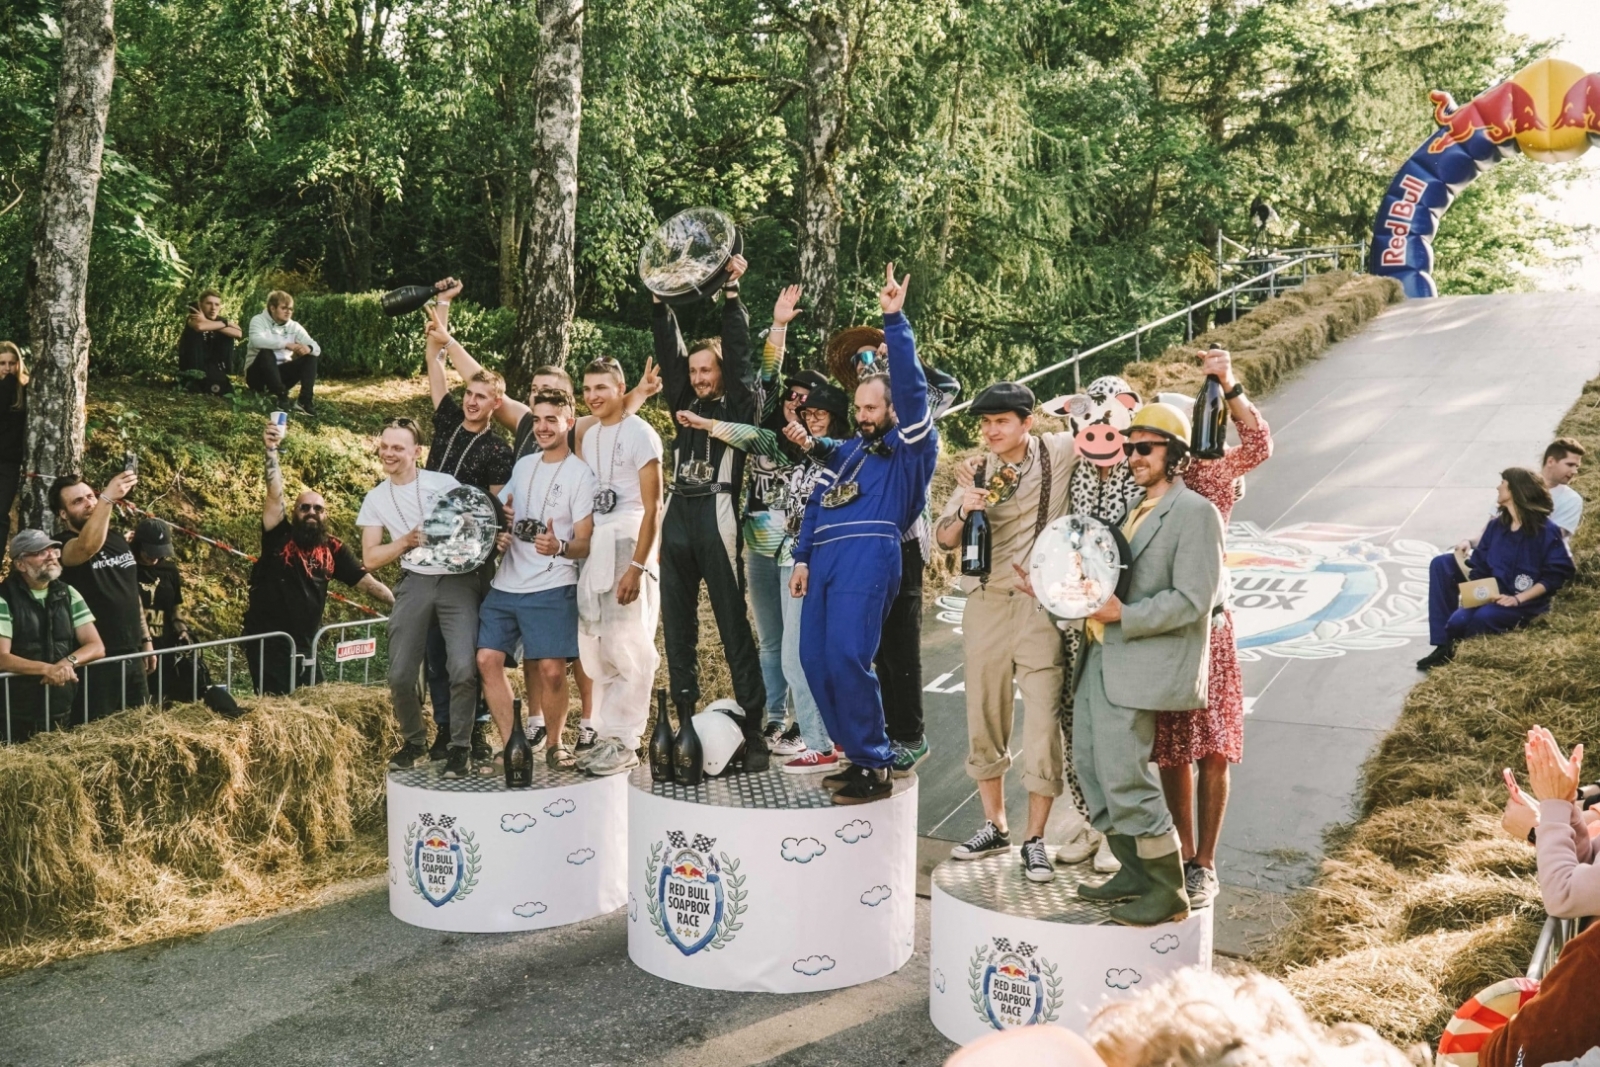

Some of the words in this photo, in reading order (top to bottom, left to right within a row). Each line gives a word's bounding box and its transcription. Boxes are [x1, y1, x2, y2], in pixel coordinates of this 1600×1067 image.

[1389, 175, 1427, 220] Bull
[1383, 220, 1410, 265] Red
[1230, 577, 1309, 593] ULL
[422, 852, 434, 863] RED
[436, 854, 453, 865] BULL
[421, 862, 454, 876] SOAPBOX
[428, 874, 446, 885] RACE
[669, 882, 685, 896] RED
[688, 886, 710, 901] BULL
[668, 896, 710, 915] SOAPBOX
[676, 912, 700, 927] RACE
[993, 979, 1009, 991] RED
[1011, 984, 1031, 997] BULL
[992, 990, 1032, 1007] SOAPBOX
[1000, 1003, 1022, 1017] RACE
